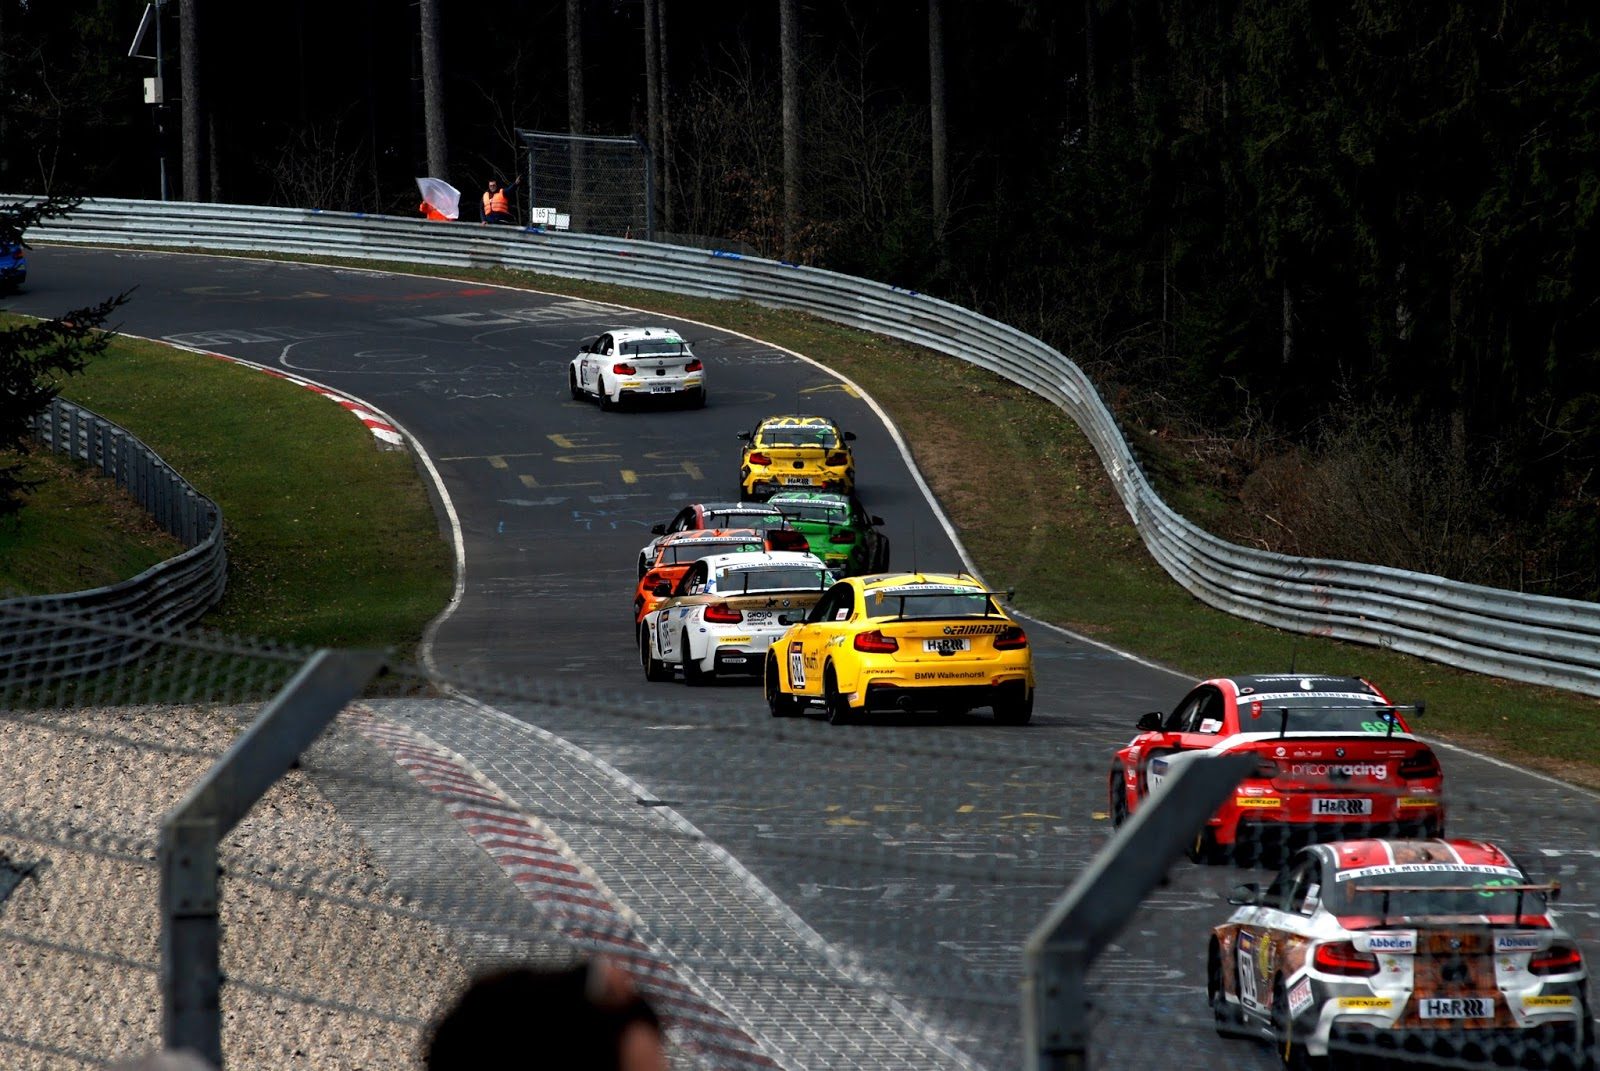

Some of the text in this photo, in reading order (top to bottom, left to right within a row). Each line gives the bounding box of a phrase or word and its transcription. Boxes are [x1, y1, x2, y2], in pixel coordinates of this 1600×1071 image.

[914, 671, 985, 680] BMW Walkenhorst
[1318, 800, 1346, 812] H&R
[1369, 938, 1413, 948] Abbelen
[1427, 1000, 1464, 1016] H&R
